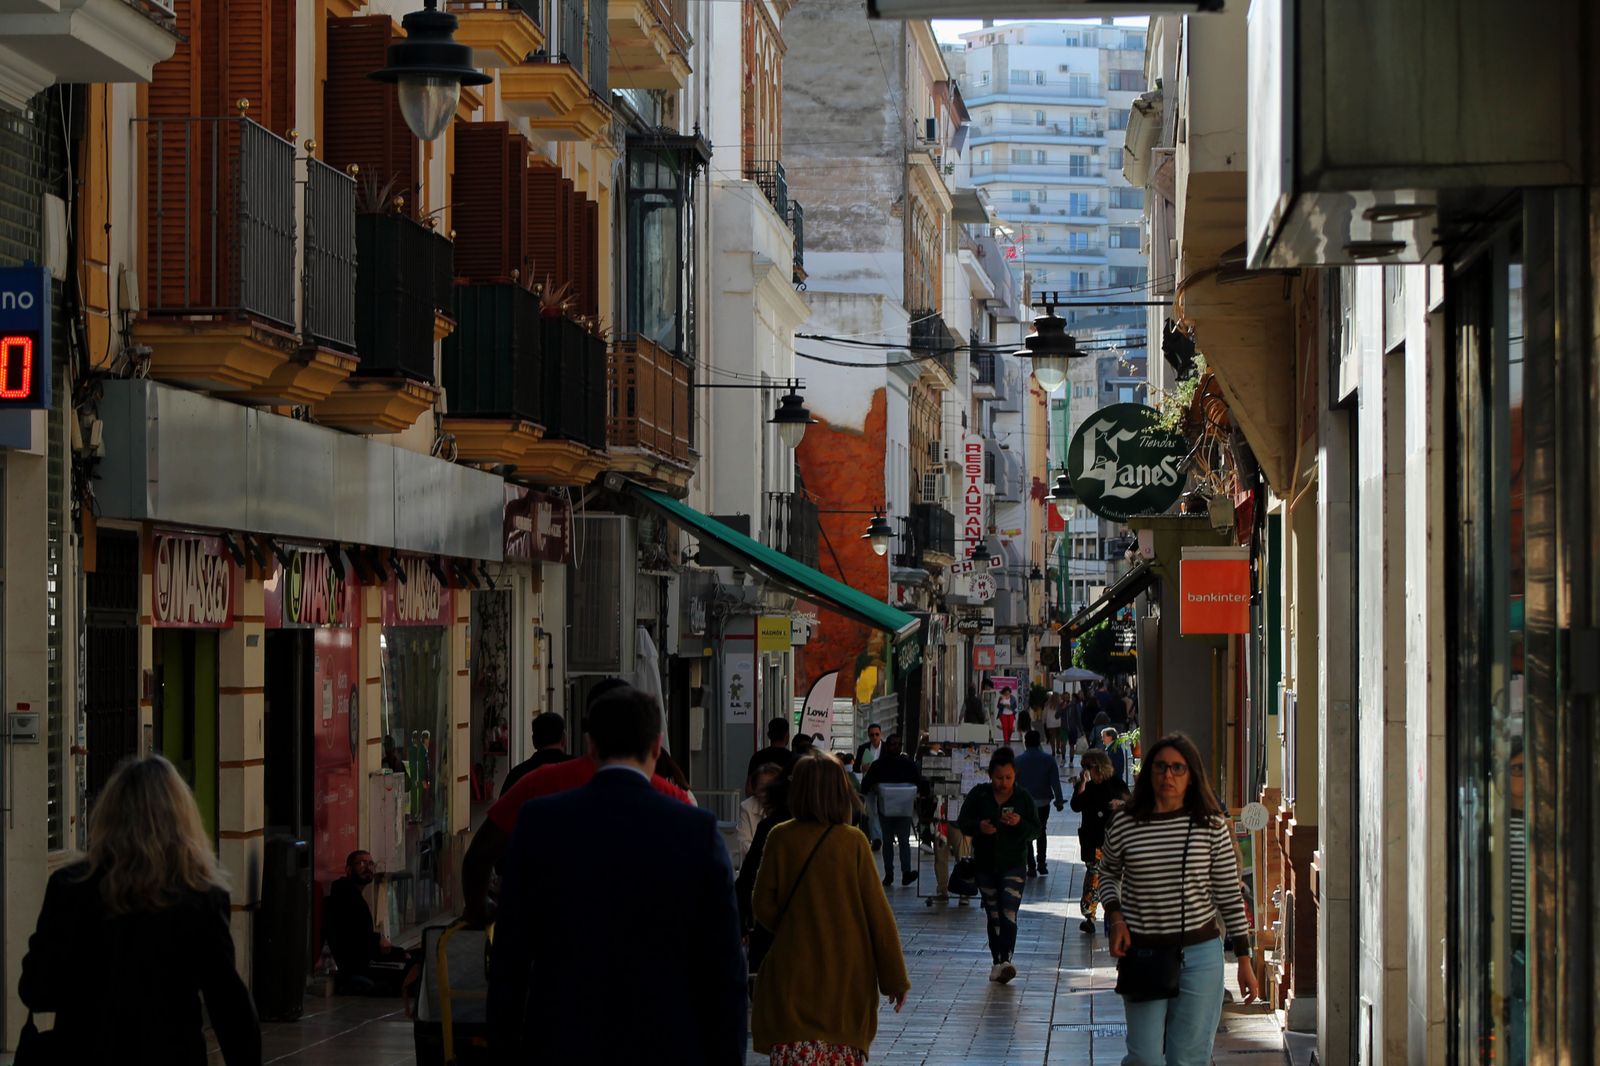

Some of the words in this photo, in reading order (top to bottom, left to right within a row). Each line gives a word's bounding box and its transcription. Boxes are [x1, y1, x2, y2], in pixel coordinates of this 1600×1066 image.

[1139, 433, 1177, 448] Tiendas
[965, 443, 982, 557] RESTAURANTE
[951, 556, 1001, 574] CHO
[807, 706, 829, 718] Lowi
